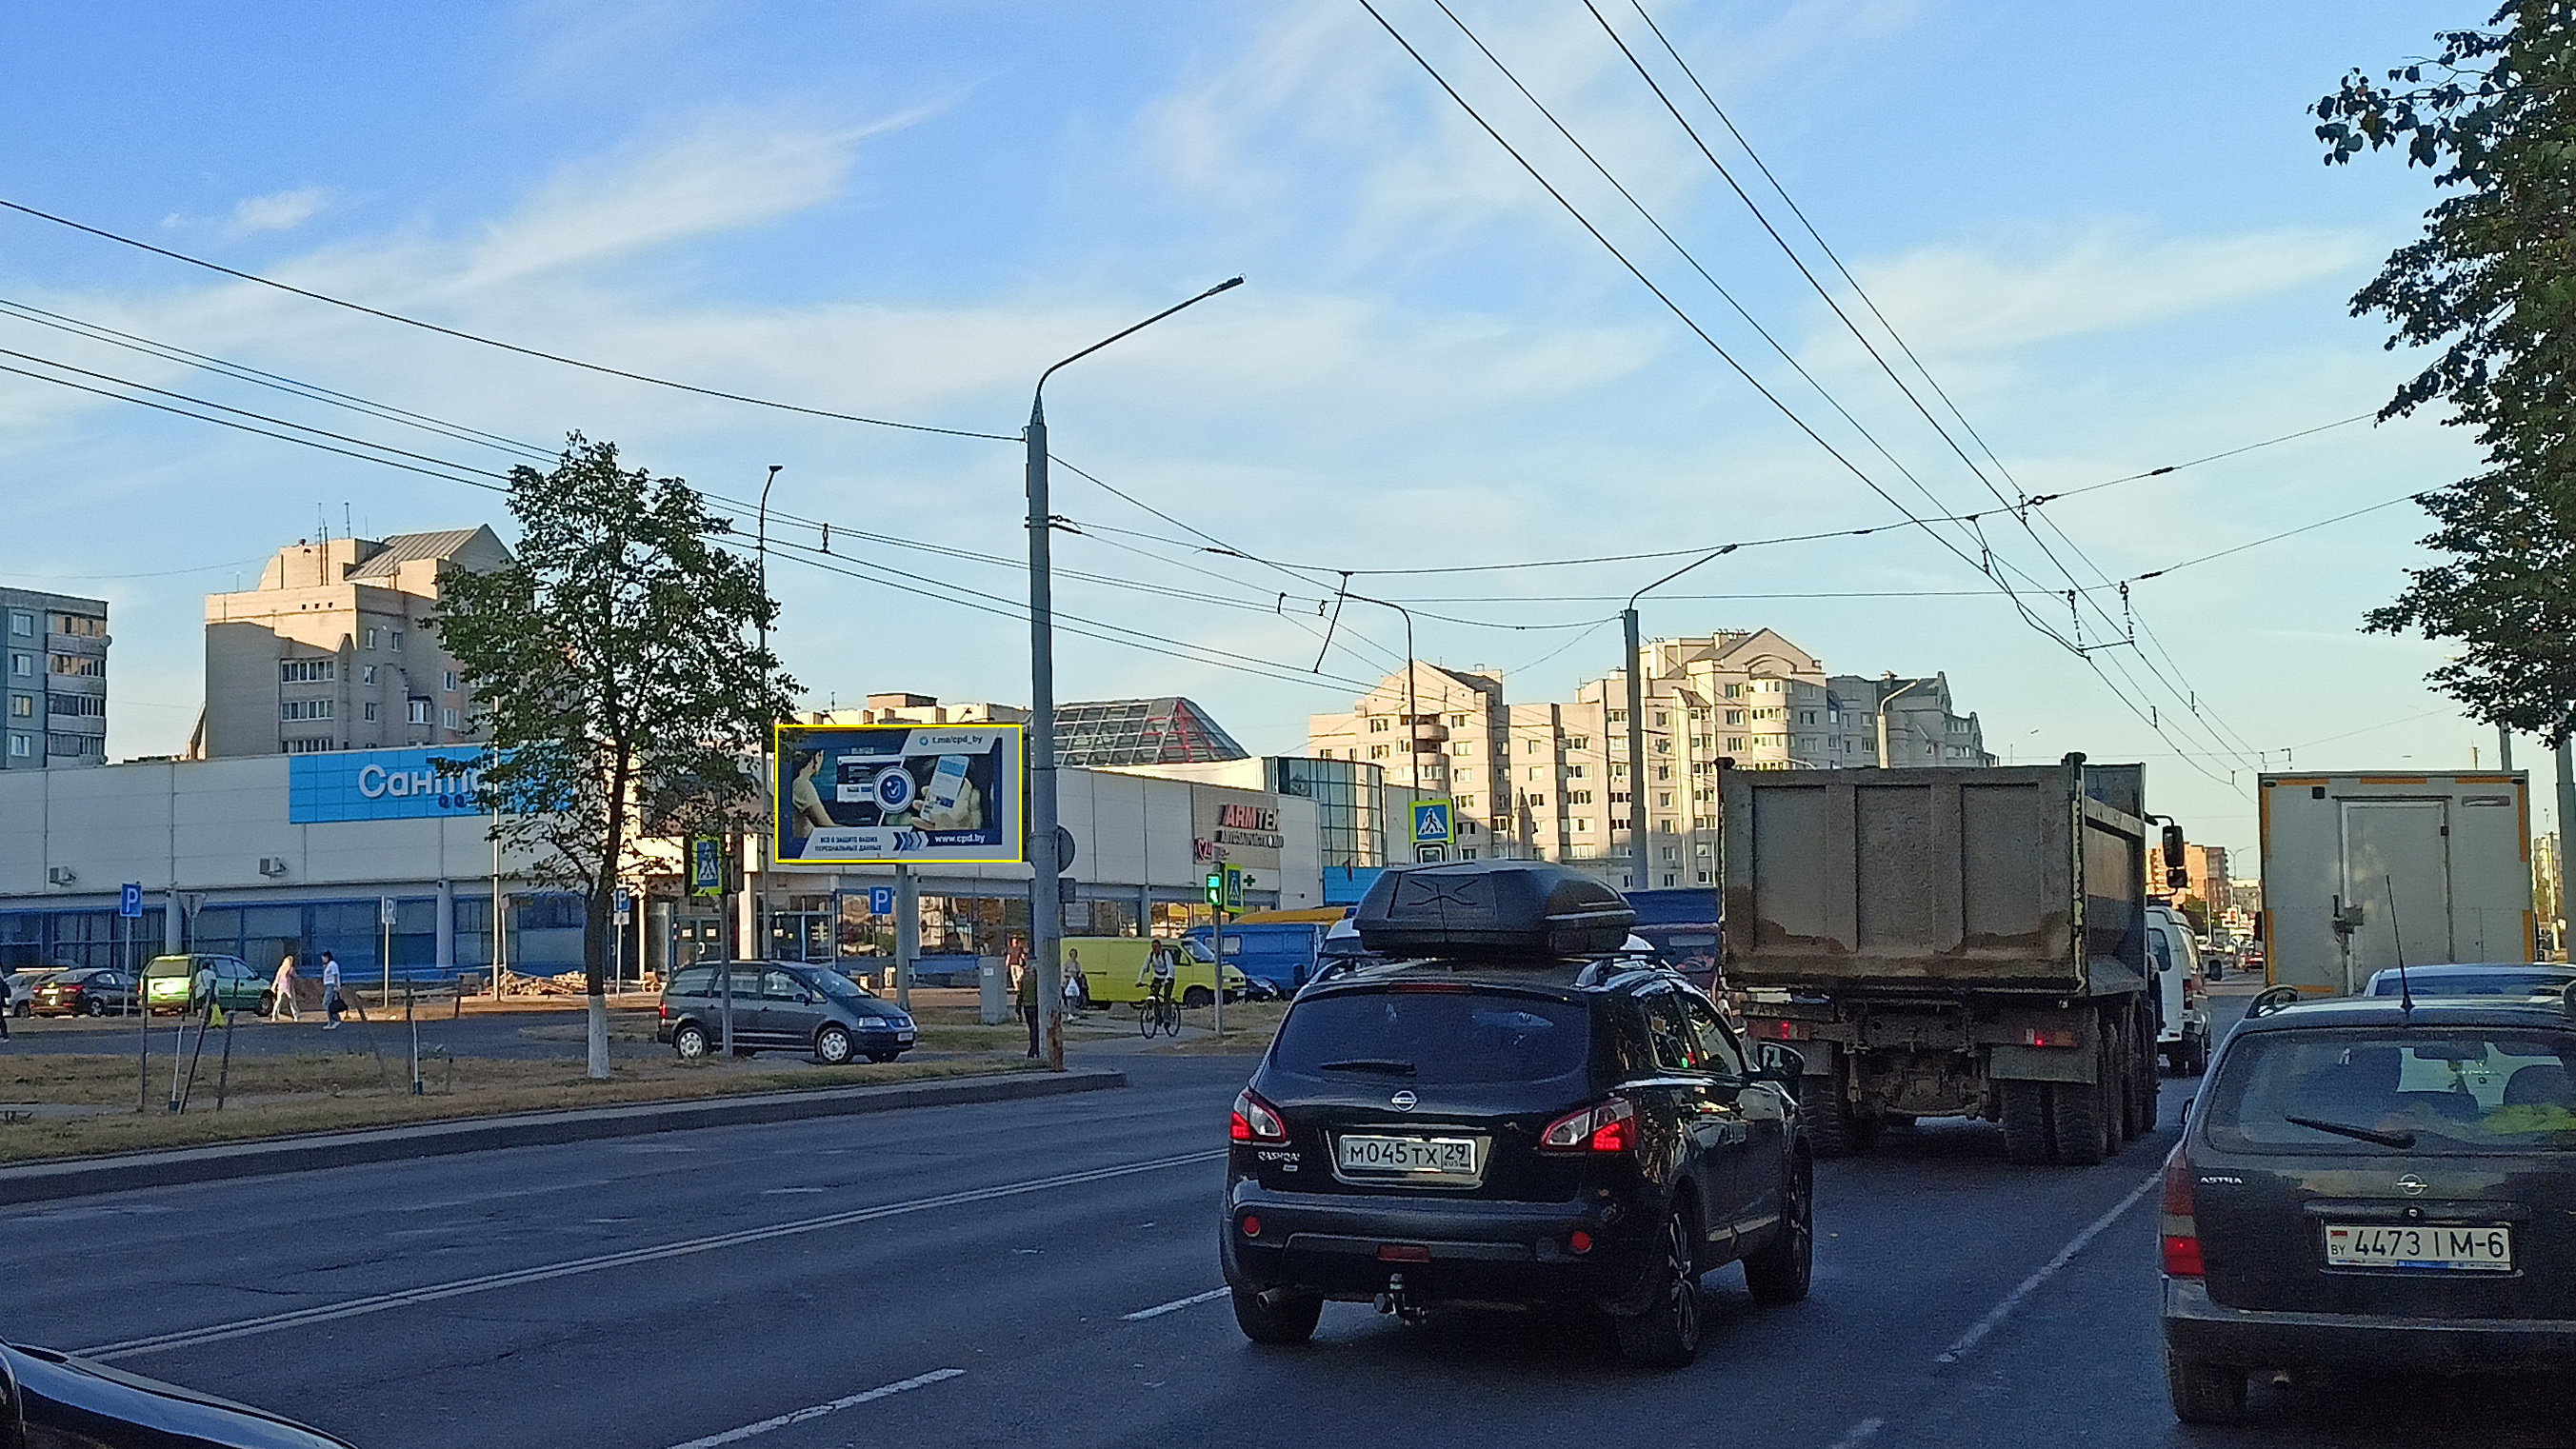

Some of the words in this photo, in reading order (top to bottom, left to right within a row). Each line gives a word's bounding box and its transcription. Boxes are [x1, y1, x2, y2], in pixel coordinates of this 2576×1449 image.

[1223, 804, 1280, 832] ARMTEK
[934, 833, 986, 844] www.cpd.by
[126, 887, 139, 913] P
[618, 889, 628, 908] P
[875, 889, 889, 912] P
[1444, 1144, 1467, 1161] 29
[2330, 1244, 2346, 1255] BY
[2354, 1229, 2421, 1257] 4473
